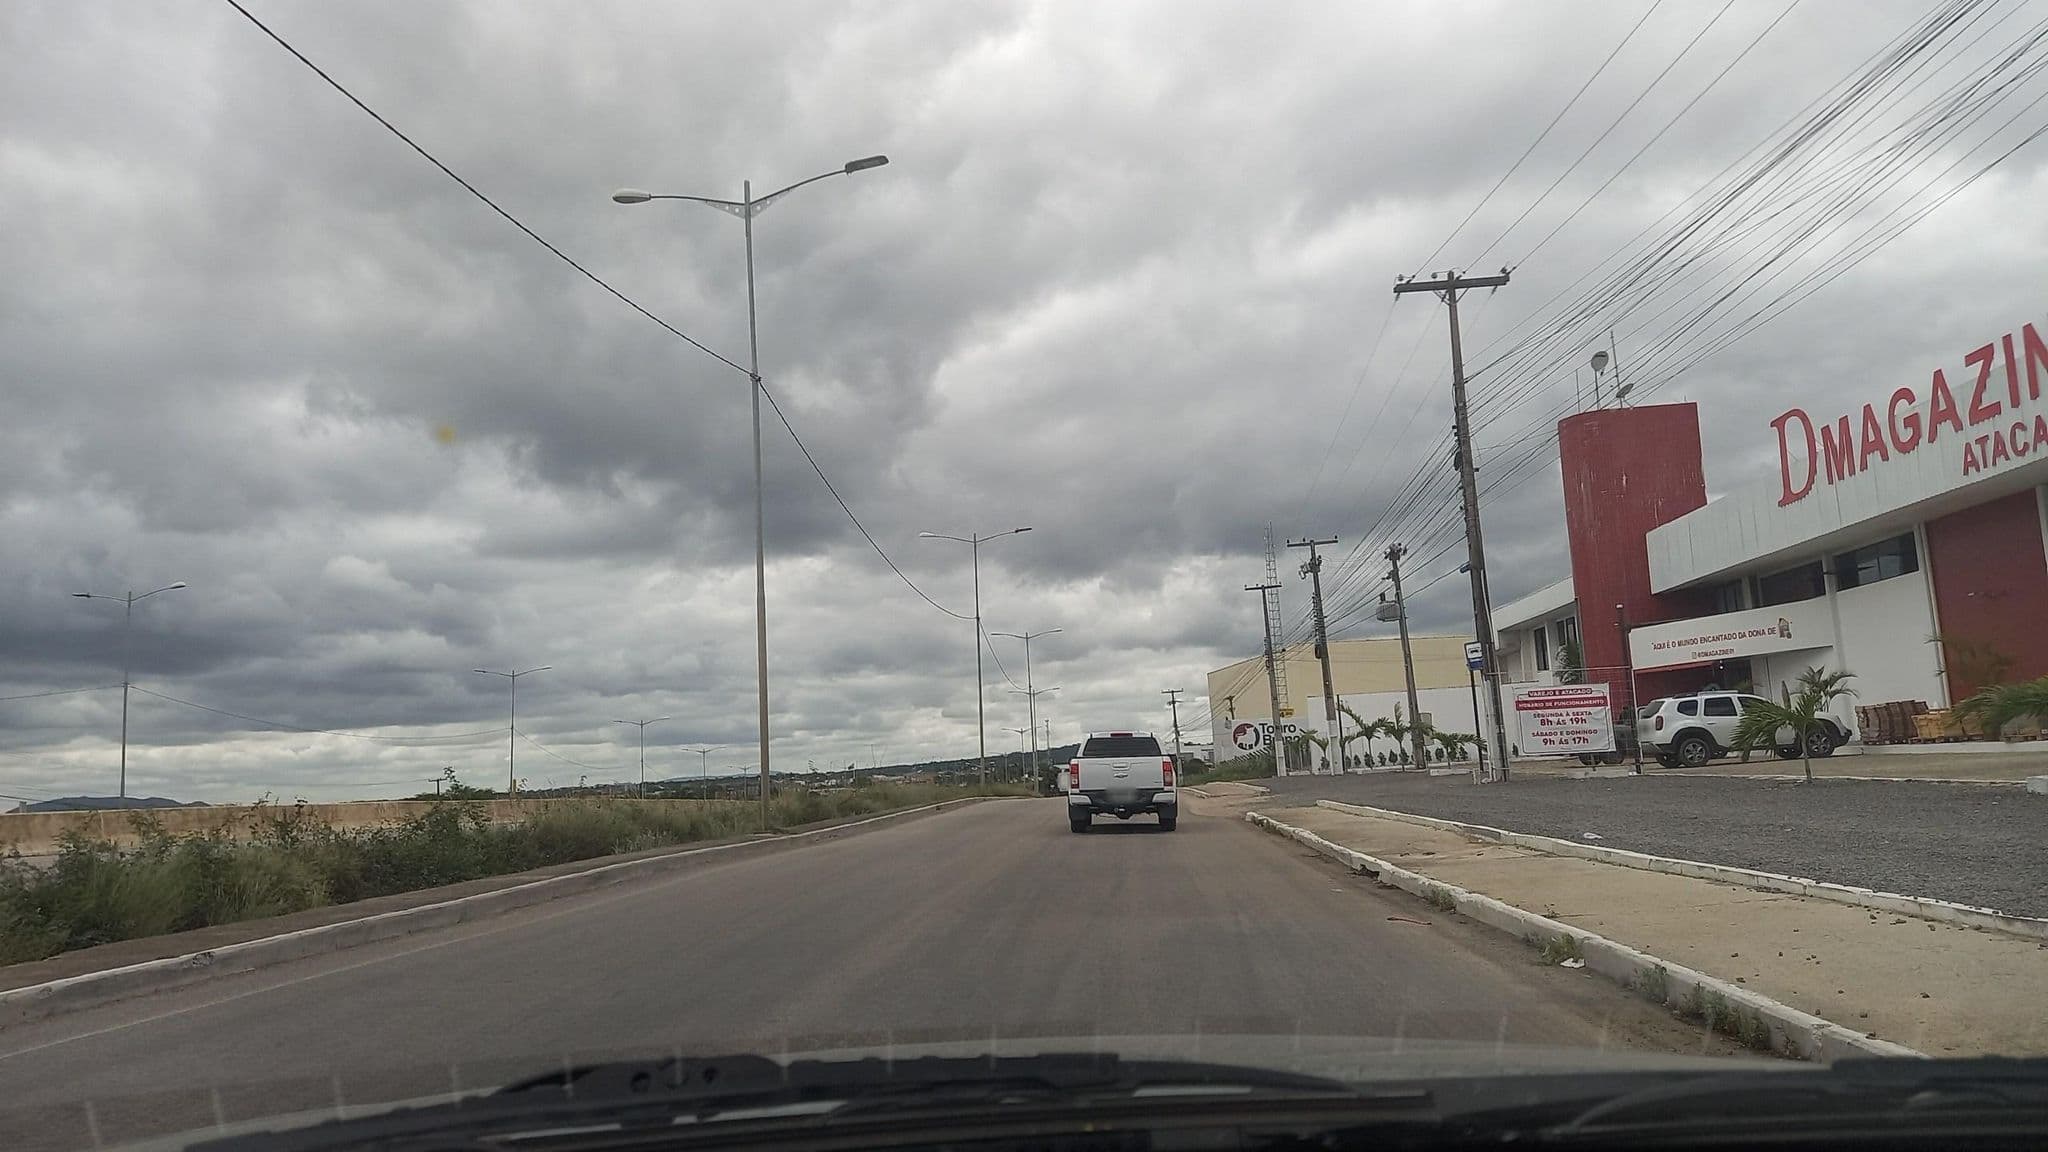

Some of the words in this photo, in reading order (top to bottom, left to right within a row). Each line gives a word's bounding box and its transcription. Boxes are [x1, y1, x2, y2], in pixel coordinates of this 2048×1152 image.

[1677, 637, 1698, 647] MUNDO
[1700, 632, 1737, 644] ENCANTADO
[1738, 631, 1747, 639] DA
[1748, 629, 1765, 637] DONA
[1767, 627, 1776, 635] DE
[1540, 718, 1553, 726] 8h
[1570, 716, 1587, 725] 19h
[1258, 723, 1296, 733] Toro
[1542, 738, 1555, 746] 9h
[1572, 736, 1589, 744] 17h
